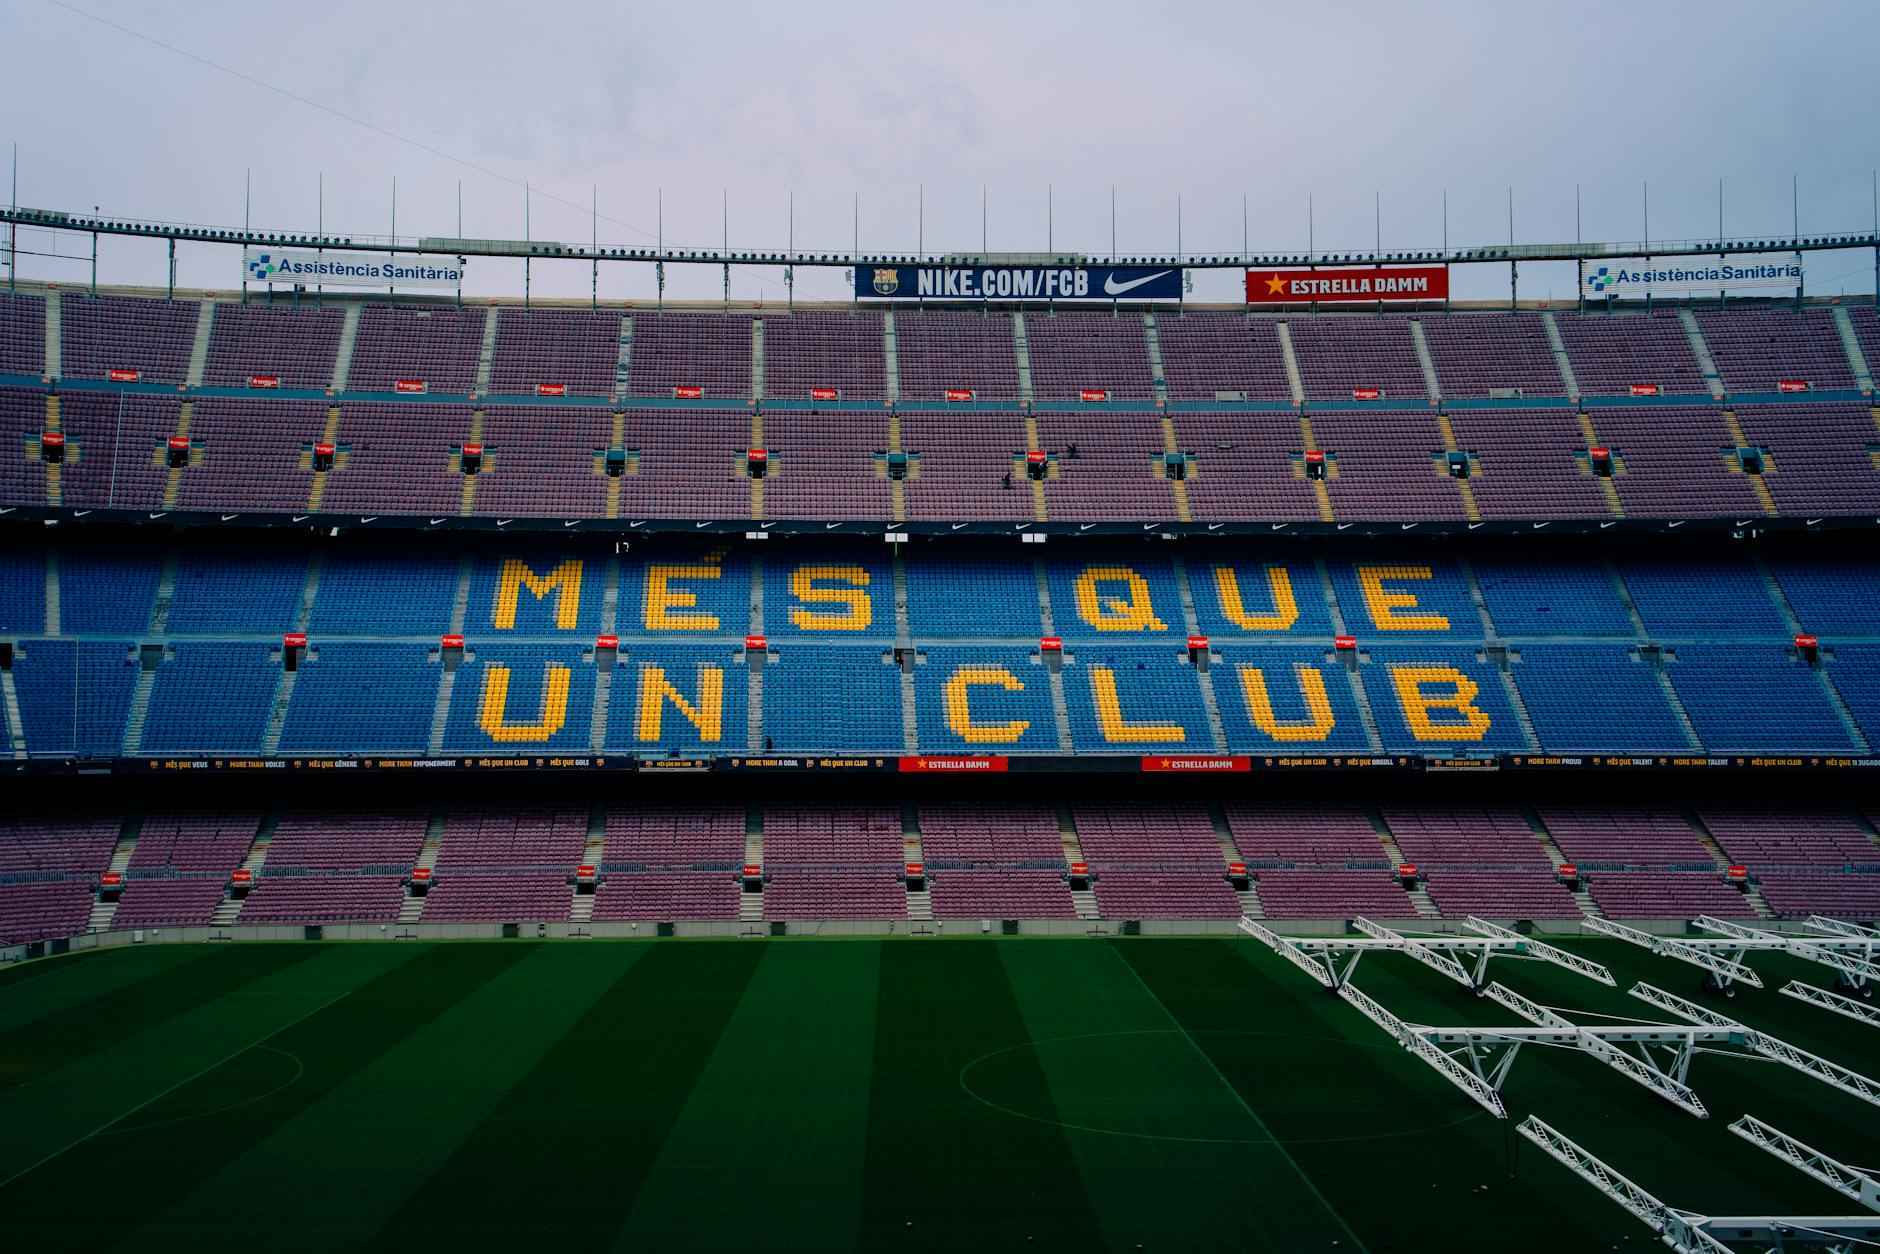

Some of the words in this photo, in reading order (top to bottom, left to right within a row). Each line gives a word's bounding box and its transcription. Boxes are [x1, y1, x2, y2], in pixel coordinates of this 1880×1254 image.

[279, 258, 379, 277] Assistència
[383, 264, 458, 280] Sanitària
[1616, 268, 1719, 283] Assistència
[1719, 264, 1801, 280] Sanitària
[917, 268, 1089, 297] NIKE.COM/FCB
[1290, 278, 1371, 295] ESTRELLA
[1374, 276, 1428, 292] DAMM
[491, 549, 873, 631] MÉS
[1073, 563, 1452, 632] QUE
[476, 662, 725, 742] UN
[942, 663, 1493, 742] CLUB
[928, 761, 966, 769] ESTRELLA
[966, 761, 990, 769] DAMM
[1171, 761, 1208, 769] ESTRELLA
[1208, 761, 1233, 769] DAMM
